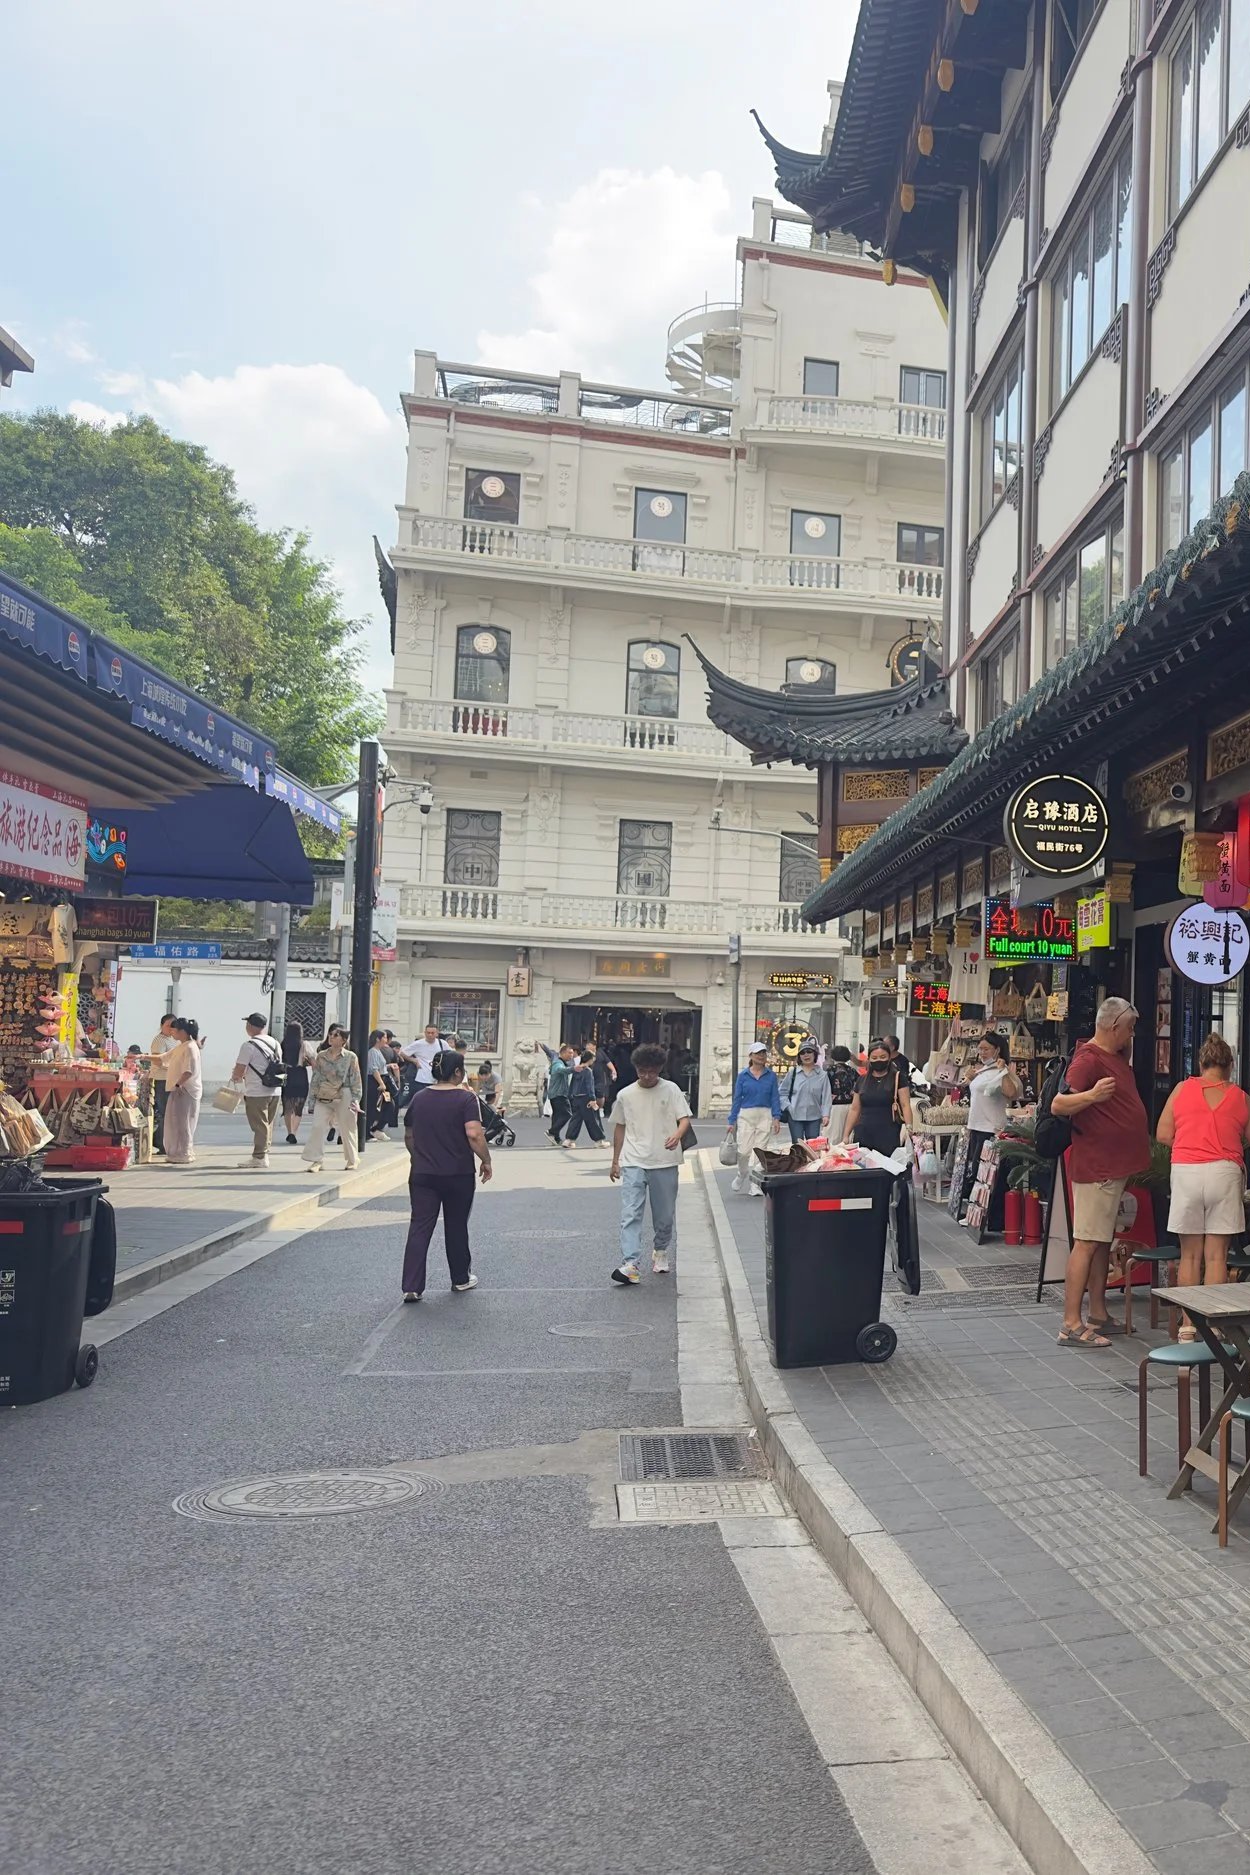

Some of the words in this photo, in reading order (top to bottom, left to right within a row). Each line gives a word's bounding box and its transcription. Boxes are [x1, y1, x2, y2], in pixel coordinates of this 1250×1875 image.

[1022, 798, 1099, 824] 启豫酒店
[1038, 823, 1057, 832] QIYU
[1058, 825, 1083, 833] HOTEL
[1036, 841, 1084, 854] 福民街76号
[1219, 841, 1232, 894] 蟹黄面
[106, 928, 124, 939] bags
[124, 929, 133, 937] 10
[133, 930, 151, 939] yuan
[1178, 917, 1244, 945] 裕興記
[154, 945, 199, 957] 福佑路
[989, 937, 1009, 953] Full
[1009, 940, 1036, 954] court
[1037, 940, 1048, 954] 10
[1050, 943, 1073, 956] yuan
[914, 984, 949, 1001] 老上海
[914, 1000, 962, 1017] 上海特
